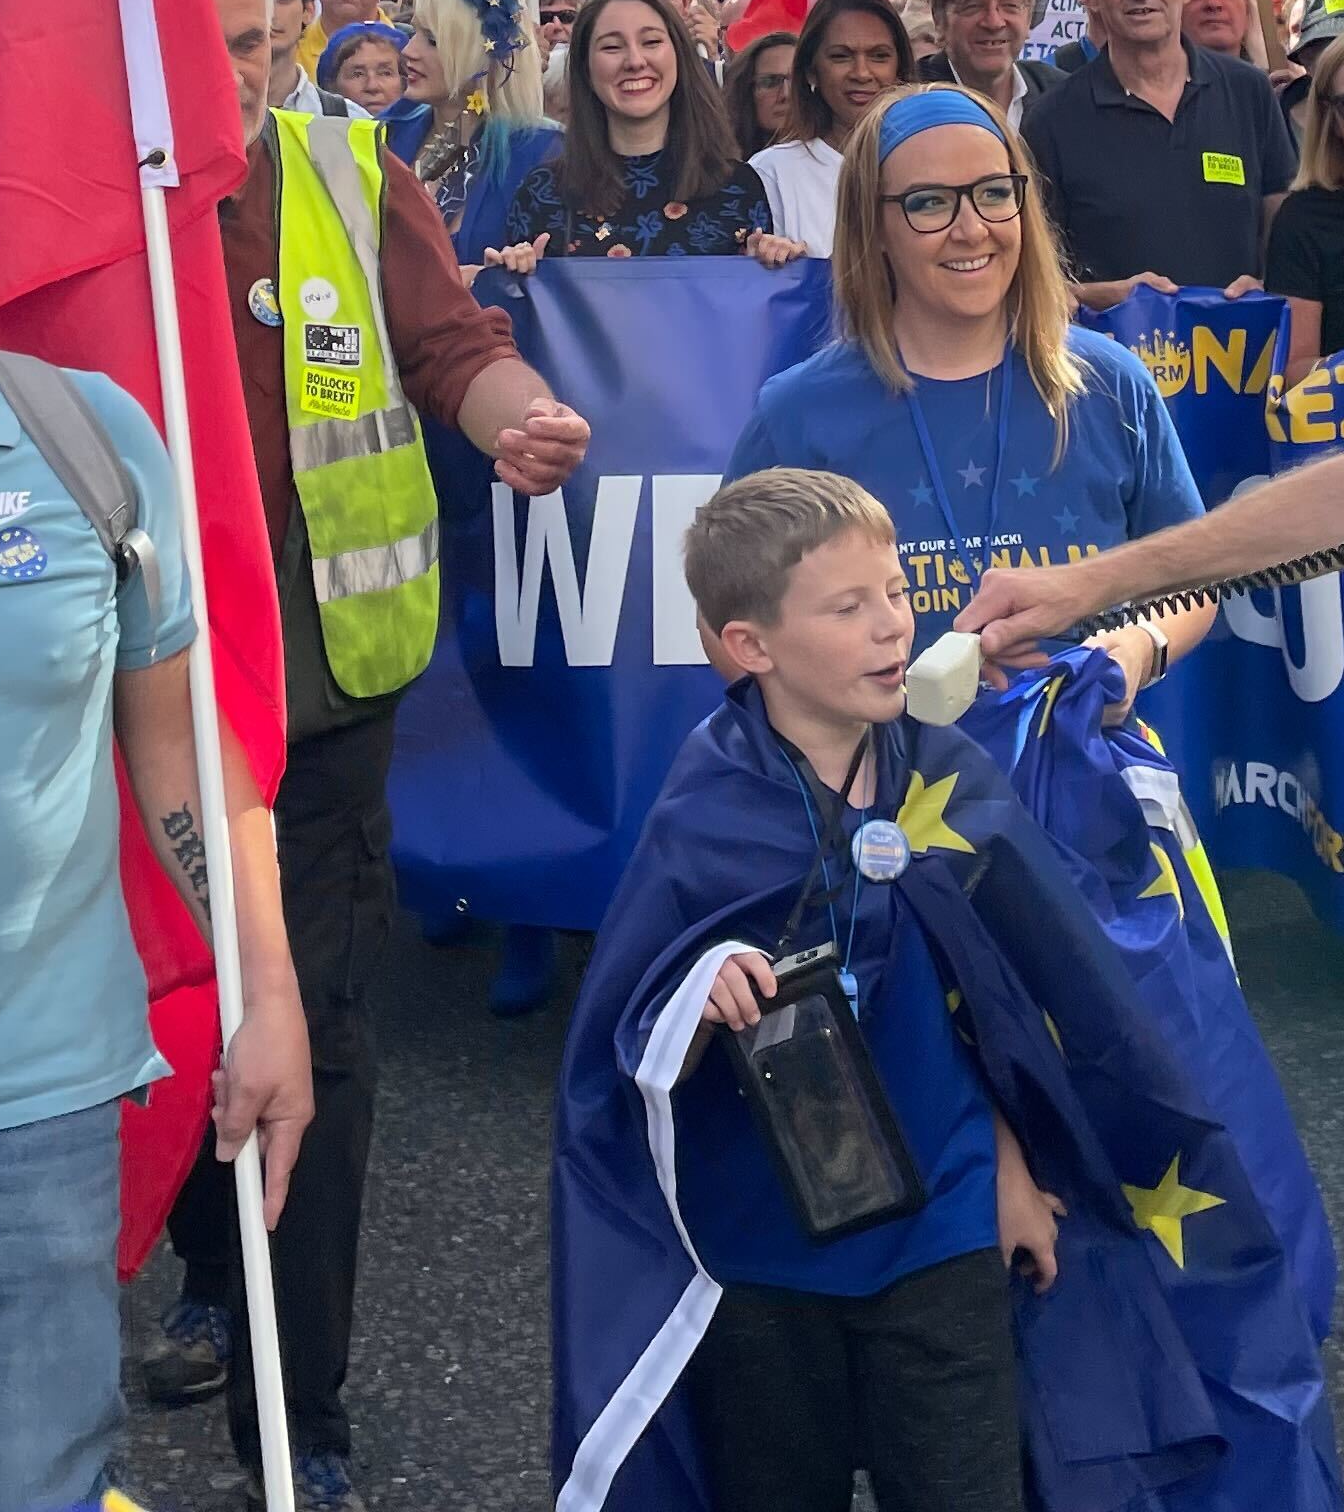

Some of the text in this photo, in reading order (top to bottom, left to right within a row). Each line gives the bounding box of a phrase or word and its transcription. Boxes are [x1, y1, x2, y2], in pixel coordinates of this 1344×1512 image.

[332, 343, 358, 352] BACK
[306, 371, 355, 393] BOLLOCKS
[306, 384, 355, 405] TO BREXIT
[919, 539, 946, 552] OUR
